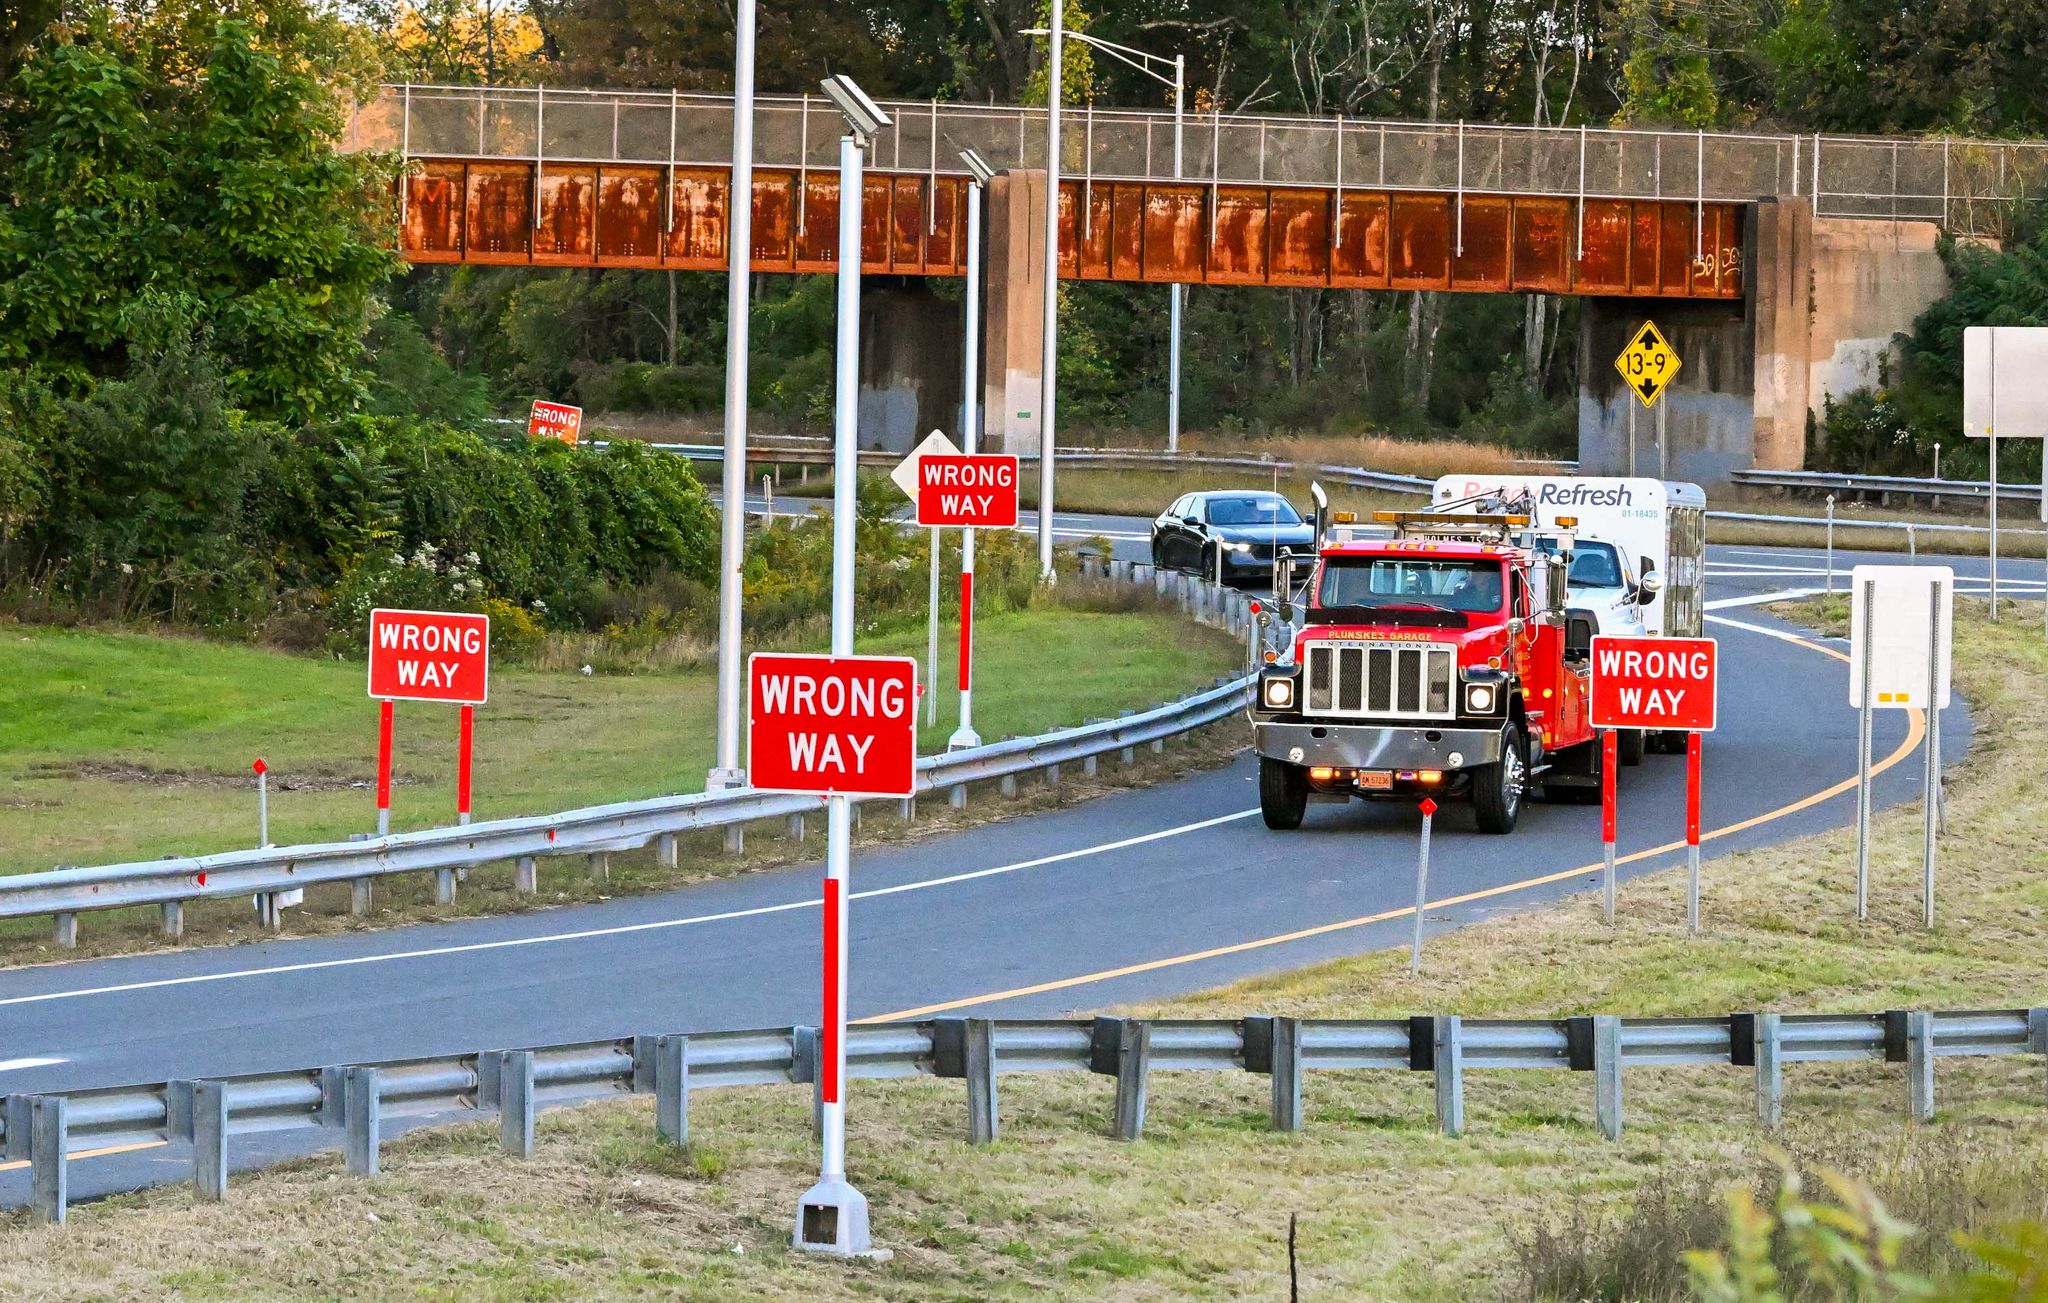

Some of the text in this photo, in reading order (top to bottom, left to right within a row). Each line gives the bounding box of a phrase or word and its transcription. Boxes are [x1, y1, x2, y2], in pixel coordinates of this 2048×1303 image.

[924, 464, 1012, 487] WRONG
[941, 494, 993, 516] WAY
[1622, 509, 1658, 518] 01-18435
[379, 623, 480, 654] WRONG
[1320, 641, 1441, 649] INTERNATIONAL
[1328, 631, 1432, 641] PLUNSKES GARAGE
[398, 660, 459, 688] WAY
[1599, 650, 1708, 679] WRONG
[760, 675, 904, 718] WRONG
[1619, 688, 1686, 716] WAY
[788, 732, 875, 774] WAY
